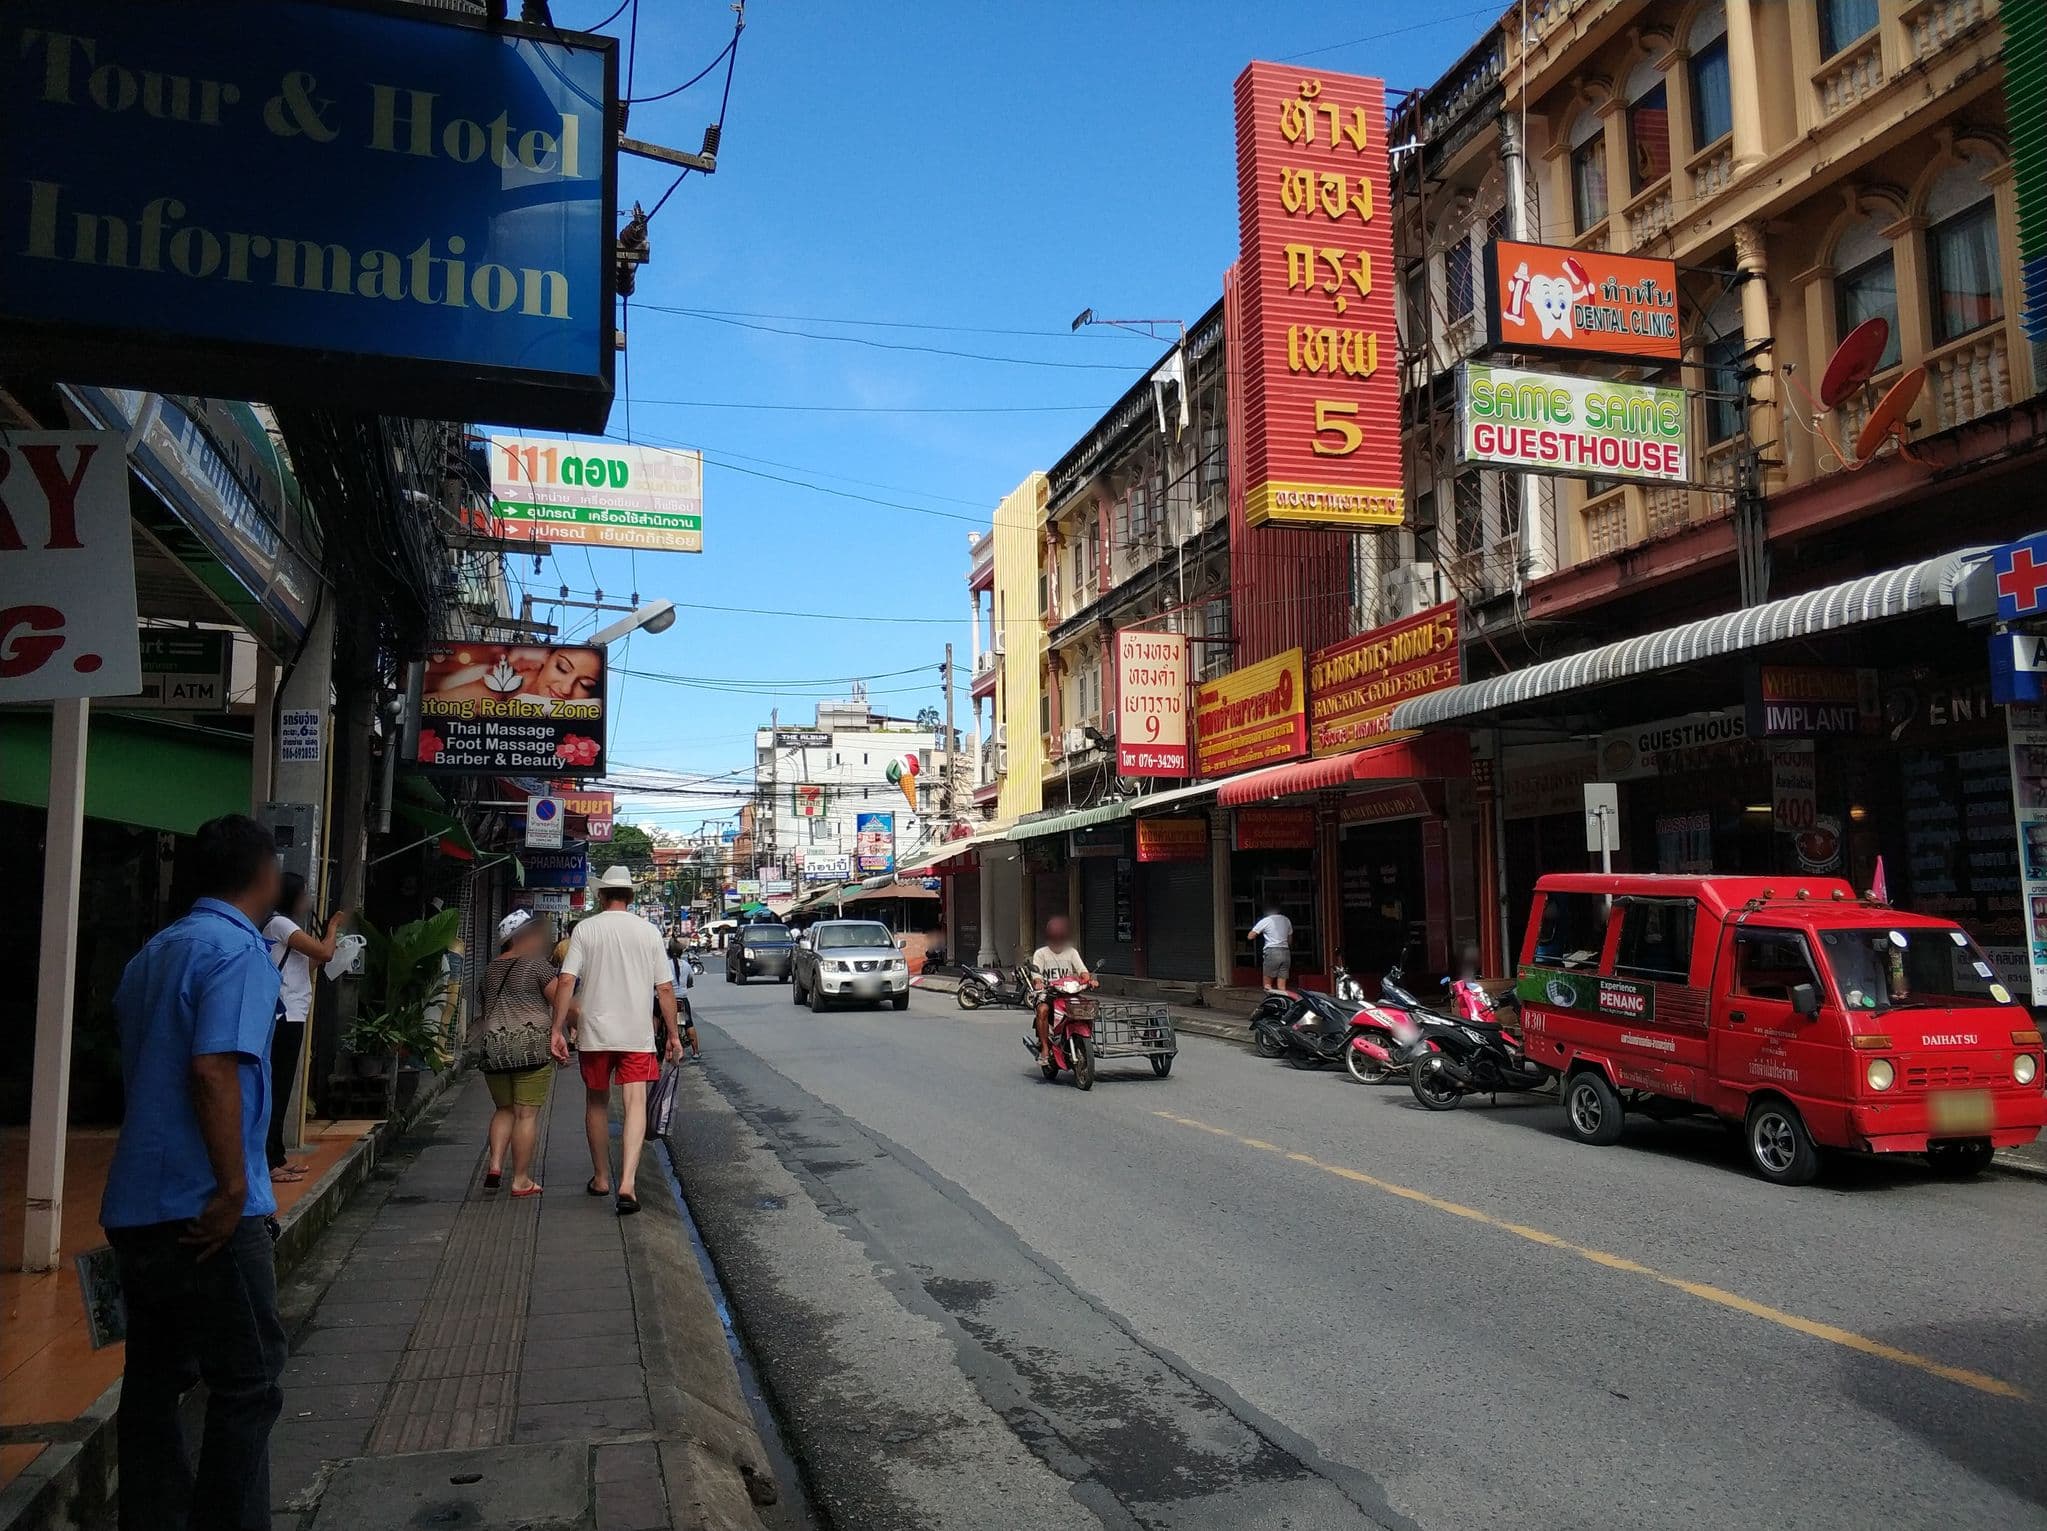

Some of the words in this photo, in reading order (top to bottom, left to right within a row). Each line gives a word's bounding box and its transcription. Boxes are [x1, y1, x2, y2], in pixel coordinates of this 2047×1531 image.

[20, 28, 240, 126] Tour
[263, 71, 341, 142] &
[364, 83, 582, 178] Hotel
[1281, 166, 1373, 222] ทอง
[19, 180, 573, 320] Information
[1284, 244, 1372, 313] กรุง
[1600, 277, 1674, 308] ทำฟัน
[1574, 304, 1628, 334] DENTAL
[1631, 310, 1676, 338] CLINIC
[1287, 323, 1377, 378] เทพ
[1472, 379, 1573, 425] SAME
[1584, 391, 1680, 437] SAME
[1312, 400, 1363, 455] 5
[1474, 423, 1680, 474] GUESTHOUSE
[1436, 613, 1453, 652] 5
[173, 683, 213, 699] ATM
[1279, 669, 1293, 711] 9
[1314, 687, 1366, 718] BANGKOK
[1368, 677, 1401, 702] GOLD
[1404, 666, 1438, 691] SHOP
[421, 698, 474, 719] atong
[481, 698, 544, 718] Reflex
[550, 700, 600, 719] Zone
[1766, 705, 1857, 731] IMPLANT
[447, 722, 481, 735] Thai
[486, 723, 555, 739] Massage
[1146, 715, 1160, 743] 9
[1639, 716, 1745, 753] GUESTHOUS
[446, 737, 482, 750] Foot
[486, 738, 555, 754] Massage
[435, 752, 490, 765] Barber
[494, 753, 506, 765] &
[511, 754, 568, 770] Beauty
[1138, 752, 1185, 769] 076-342991
[800, 787, 820, 800] 7
[1776, 799, 1814, 826] 400
[530, 856, 583, 869] PHARMACY
[1043, 967, 1069, 980] NEW
[1600, 981, 1637, 993] Experience
[1600, 992, 1643, 1011] PENANG
[1922, 1034, 1978, 1046] DAIHATSU
